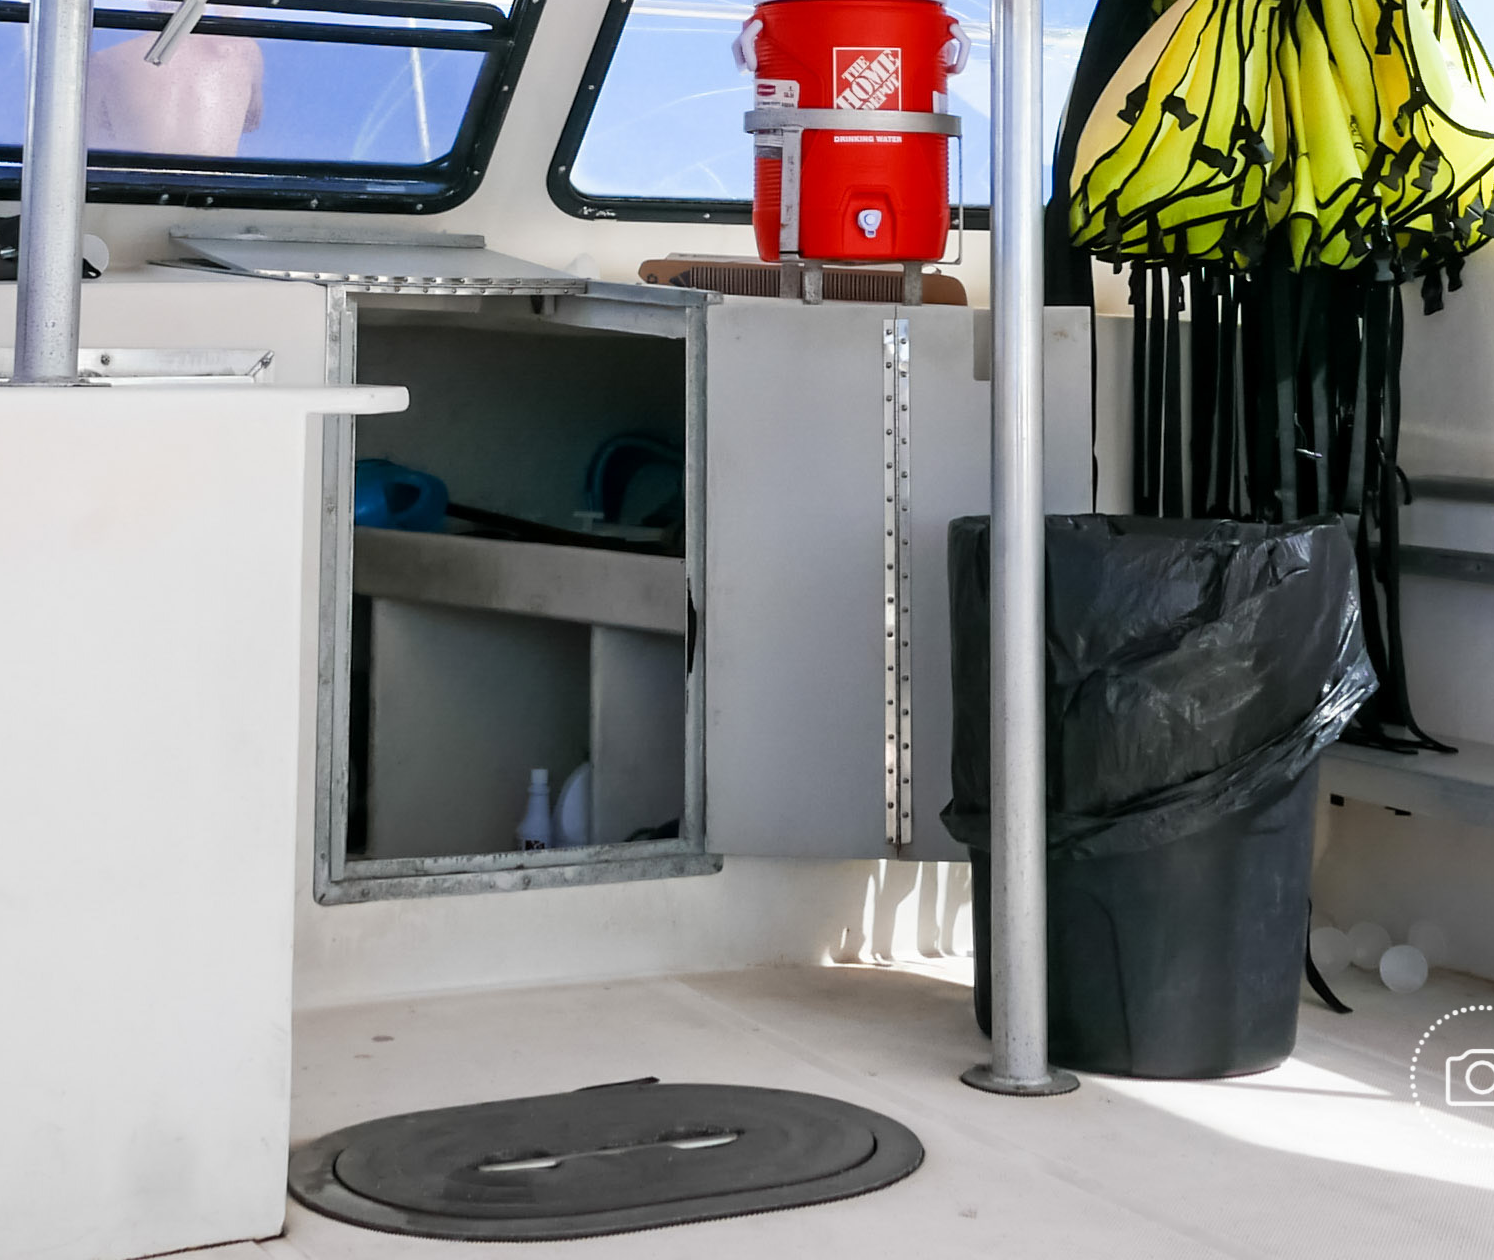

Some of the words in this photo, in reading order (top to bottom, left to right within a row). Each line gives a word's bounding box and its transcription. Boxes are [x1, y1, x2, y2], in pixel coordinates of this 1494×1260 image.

[835, 49, 899, 109] HOME
[841, 55, 869, 83] THE
[861, 73, 899, 109] DEPOT
[833, 134, 875, 143] DRINKING
[876, 134, 902, 143] WATER
